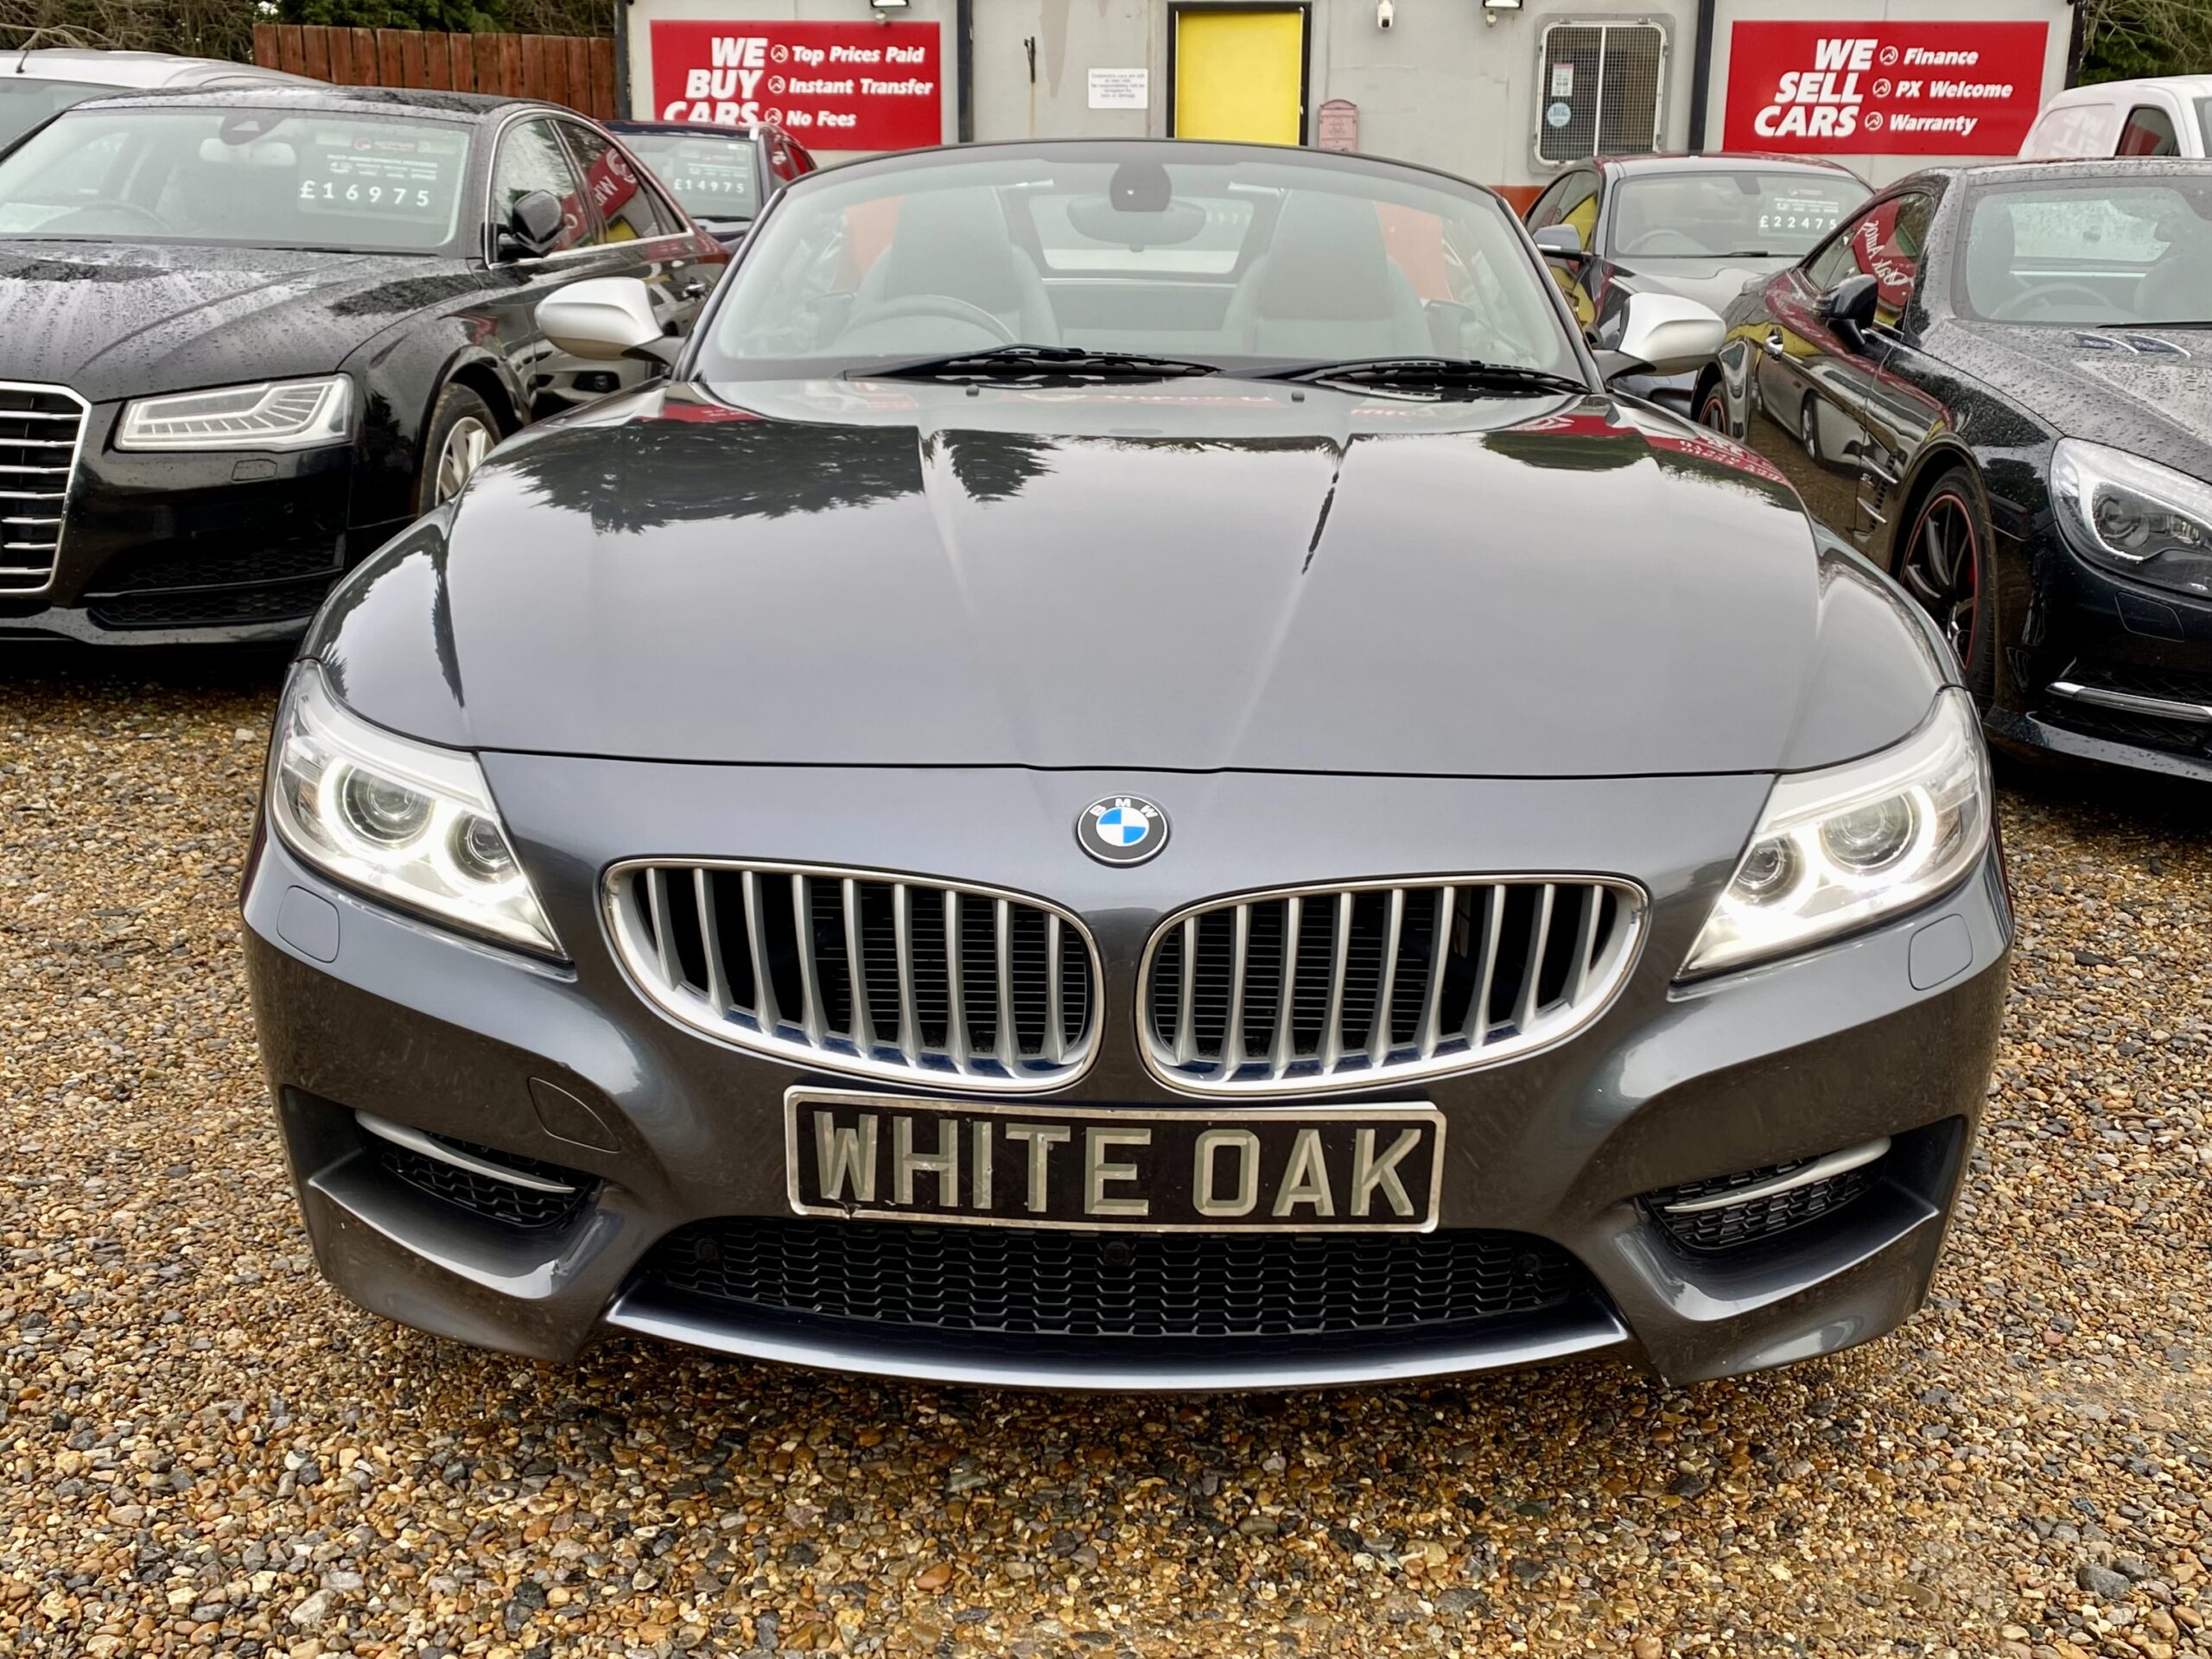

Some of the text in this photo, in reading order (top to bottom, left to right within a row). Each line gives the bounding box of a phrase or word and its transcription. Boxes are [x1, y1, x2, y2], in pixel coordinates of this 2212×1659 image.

[711, 37, 768, 67] WE
[791, 45, 925, 67] Top Prices Paid
[1815, 39, 1878, 71] WE
[1904, 48, 1979, 66] Finance
[685, 68, 765, 99] BUY
[789, 78, 934, 95] Instant Transfer
[1774, 72, 1864, 104] SELL
[1896, 80, 2013, 99] PX Welcome
[663, 100, 760, 127] CARS
[786, 111, 856, 127] No Fees
[1754, 105, 1860, 137] CARS
[1890, 114, 1978, 136] Warranty
[300, 180, 429, 207] £16975
[674, 178, 744, 194] £14975
[1759, 215, 1837, 230] £22475
[1089, 798, 1159, 818] BMW
[813, 1110, 1422, 1217] WHITE OAK
